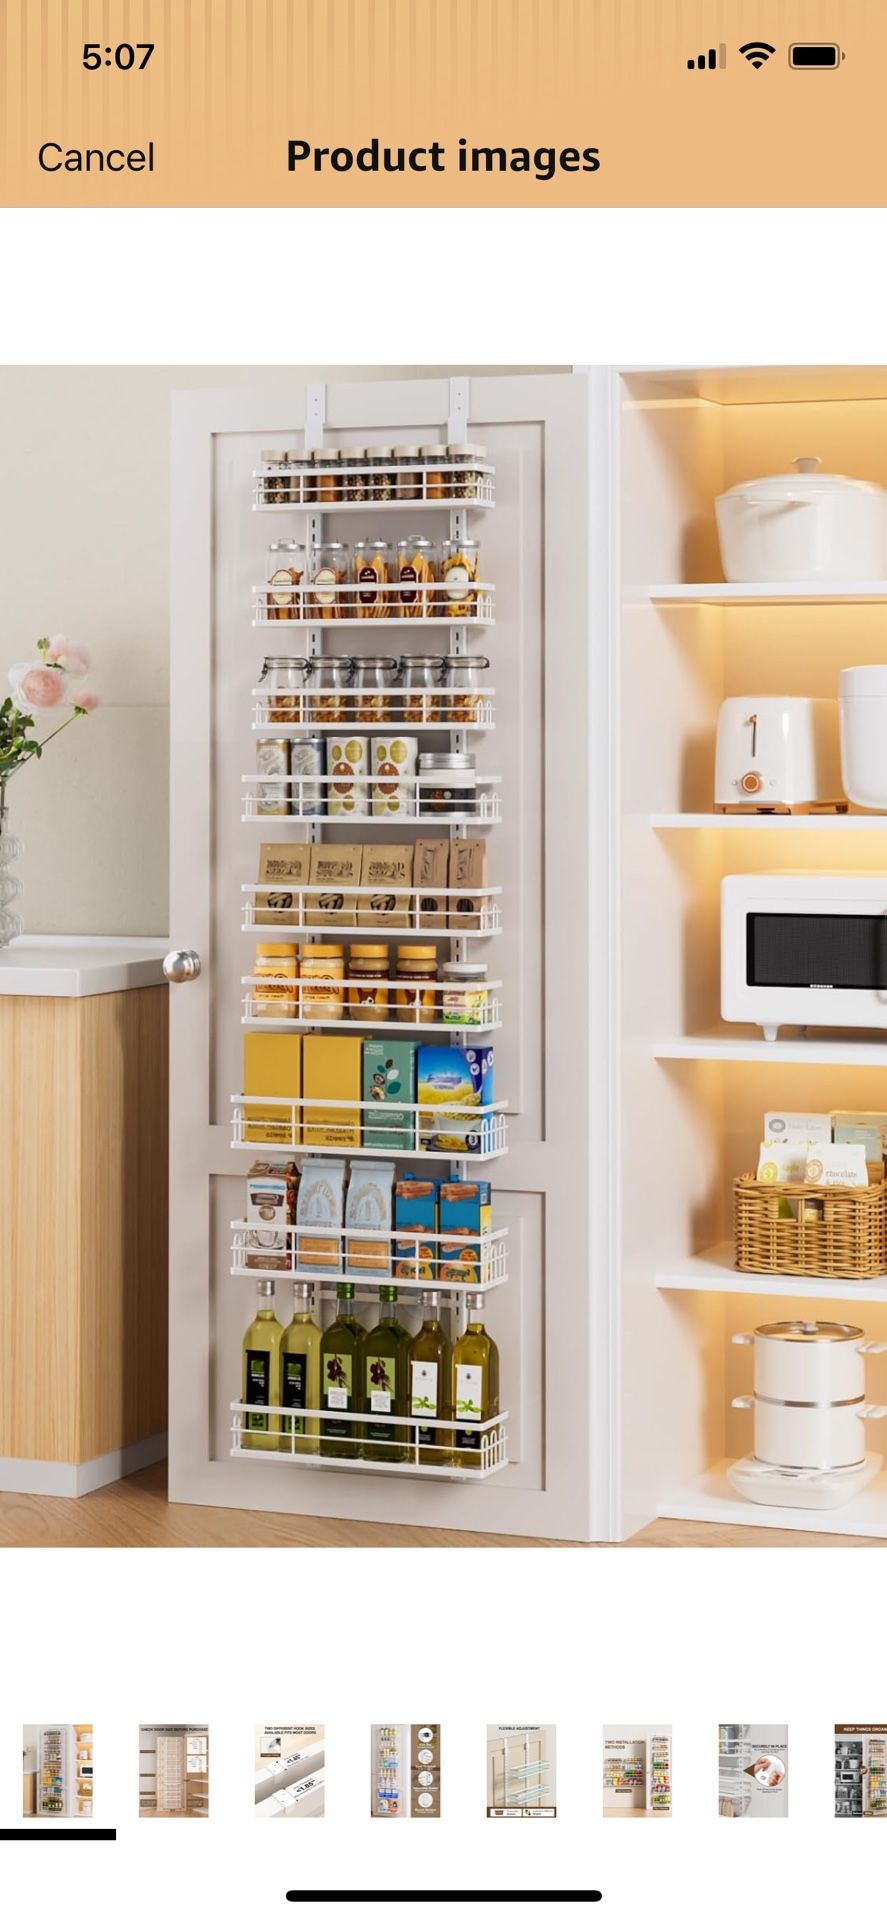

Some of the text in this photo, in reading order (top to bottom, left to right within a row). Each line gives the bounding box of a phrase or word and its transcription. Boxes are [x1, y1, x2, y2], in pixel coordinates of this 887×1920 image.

[82, 43, 155, 71] 5:07
[38, 141, 154, 172] Cancel
[287, 138, 601, 181] Product images
[825, 1169, 857, 1178] chocolate
